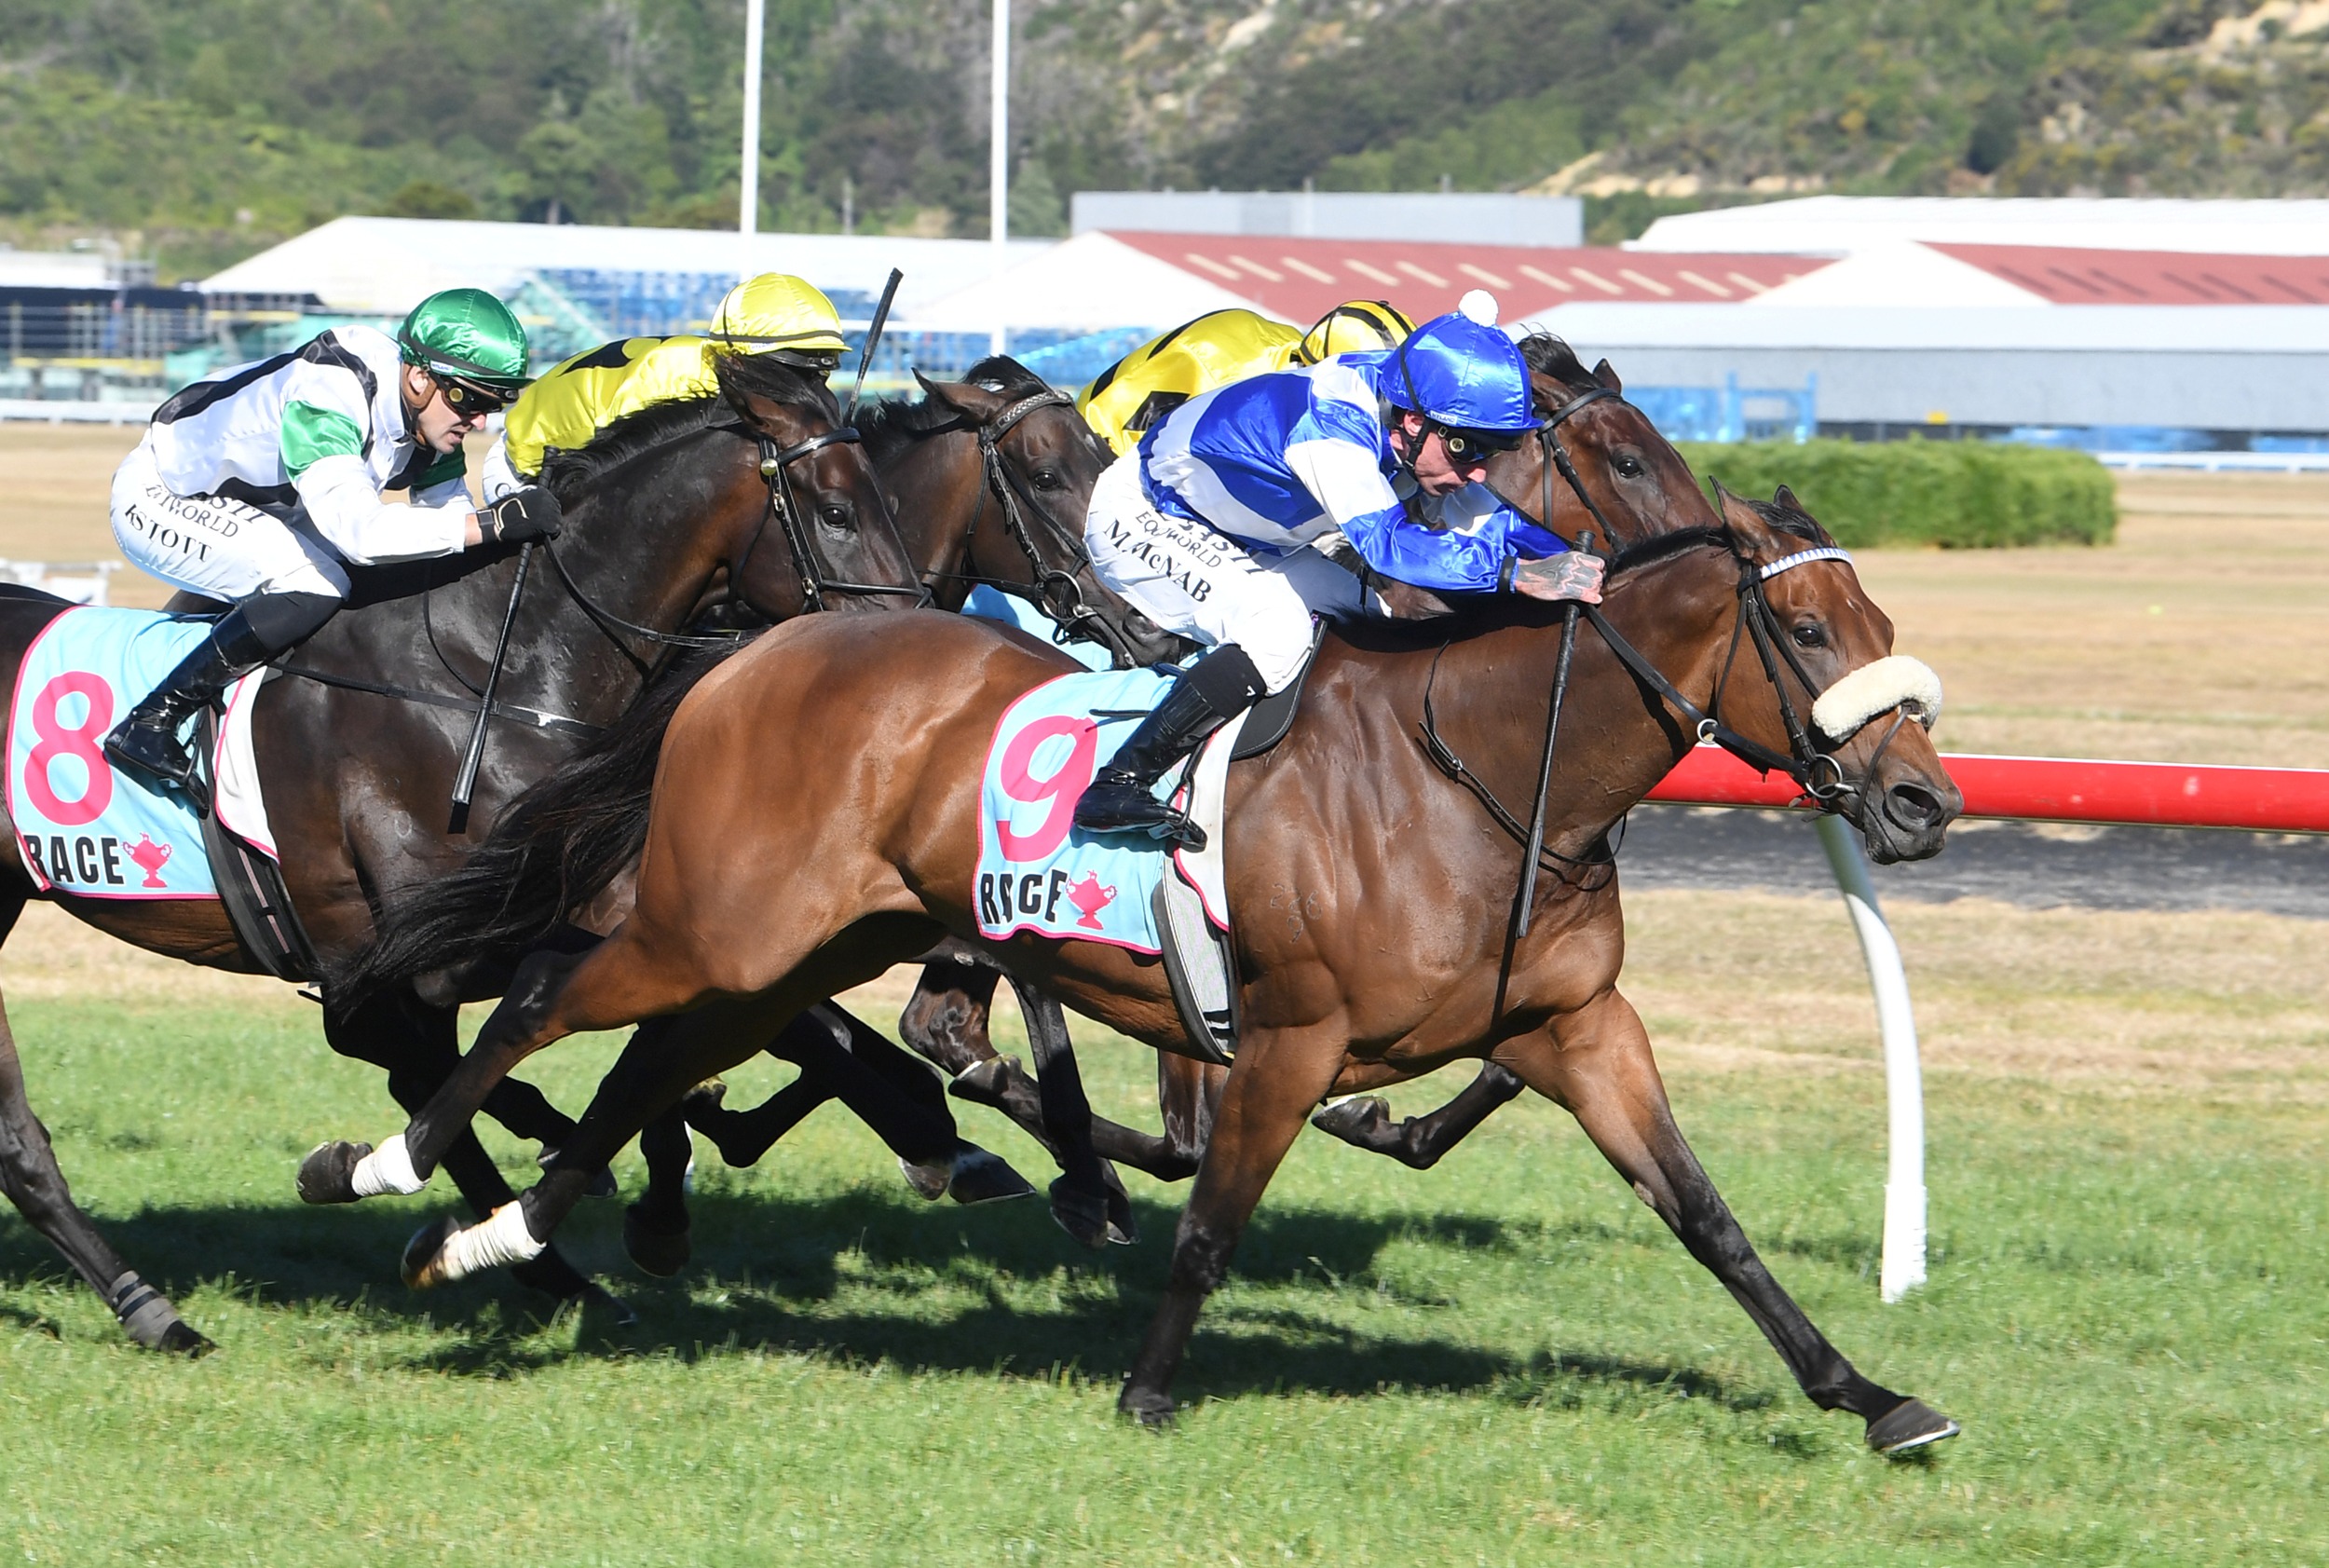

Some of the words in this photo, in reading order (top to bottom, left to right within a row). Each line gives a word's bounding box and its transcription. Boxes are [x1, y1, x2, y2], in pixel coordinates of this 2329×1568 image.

[23, 671, 115, 826] 8
[996, 715, 1098, 863] 9
[23, 835, 125, 885] RACE
